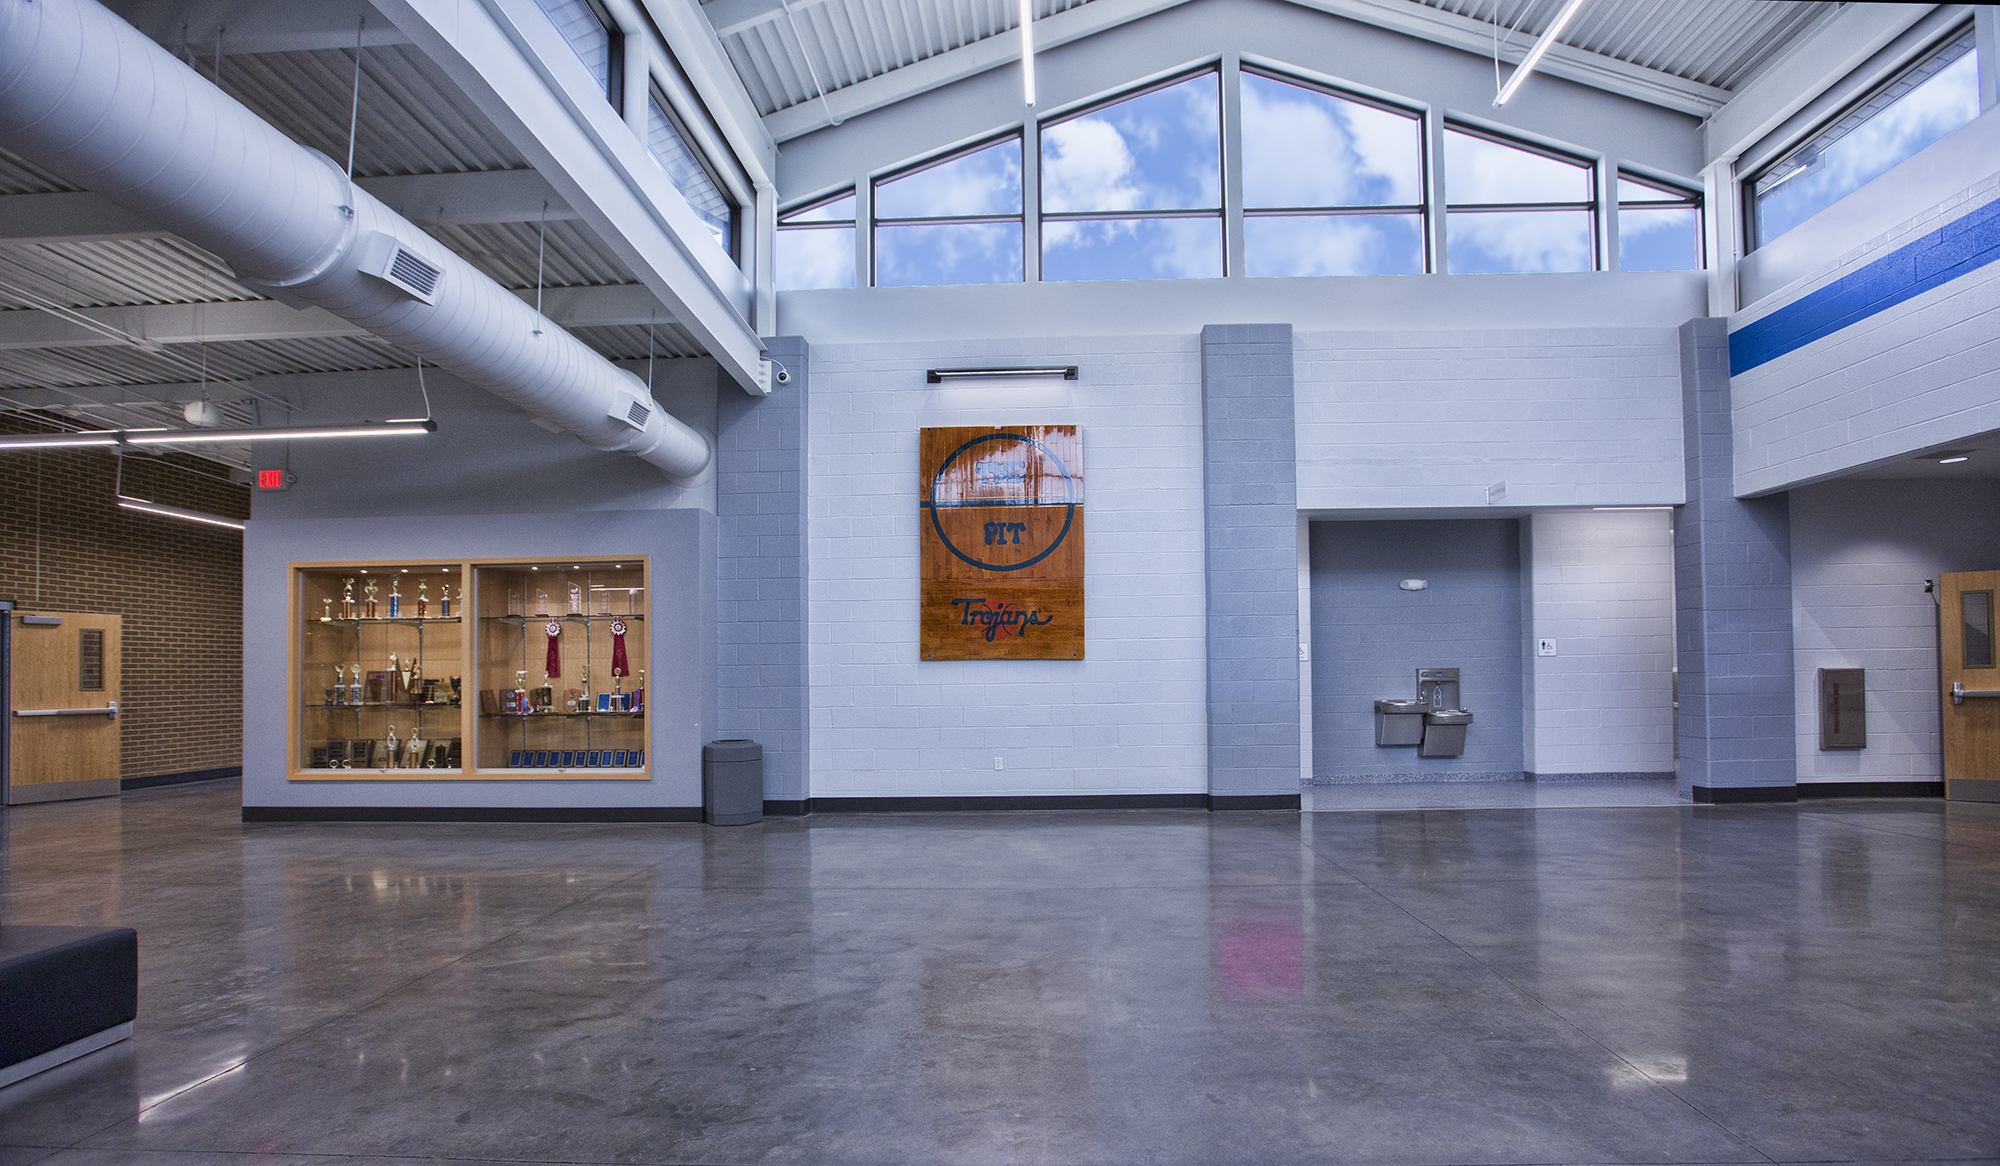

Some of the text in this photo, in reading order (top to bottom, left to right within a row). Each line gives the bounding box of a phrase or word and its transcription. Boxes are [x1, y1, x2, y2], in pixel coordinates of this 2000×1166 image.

[259, 470, 282, 488] EXIT
[975, 461, 1026, 484] THE
[983, 521, 1027, 545] PIT
[951, 598, 1054, 642] Trojans
